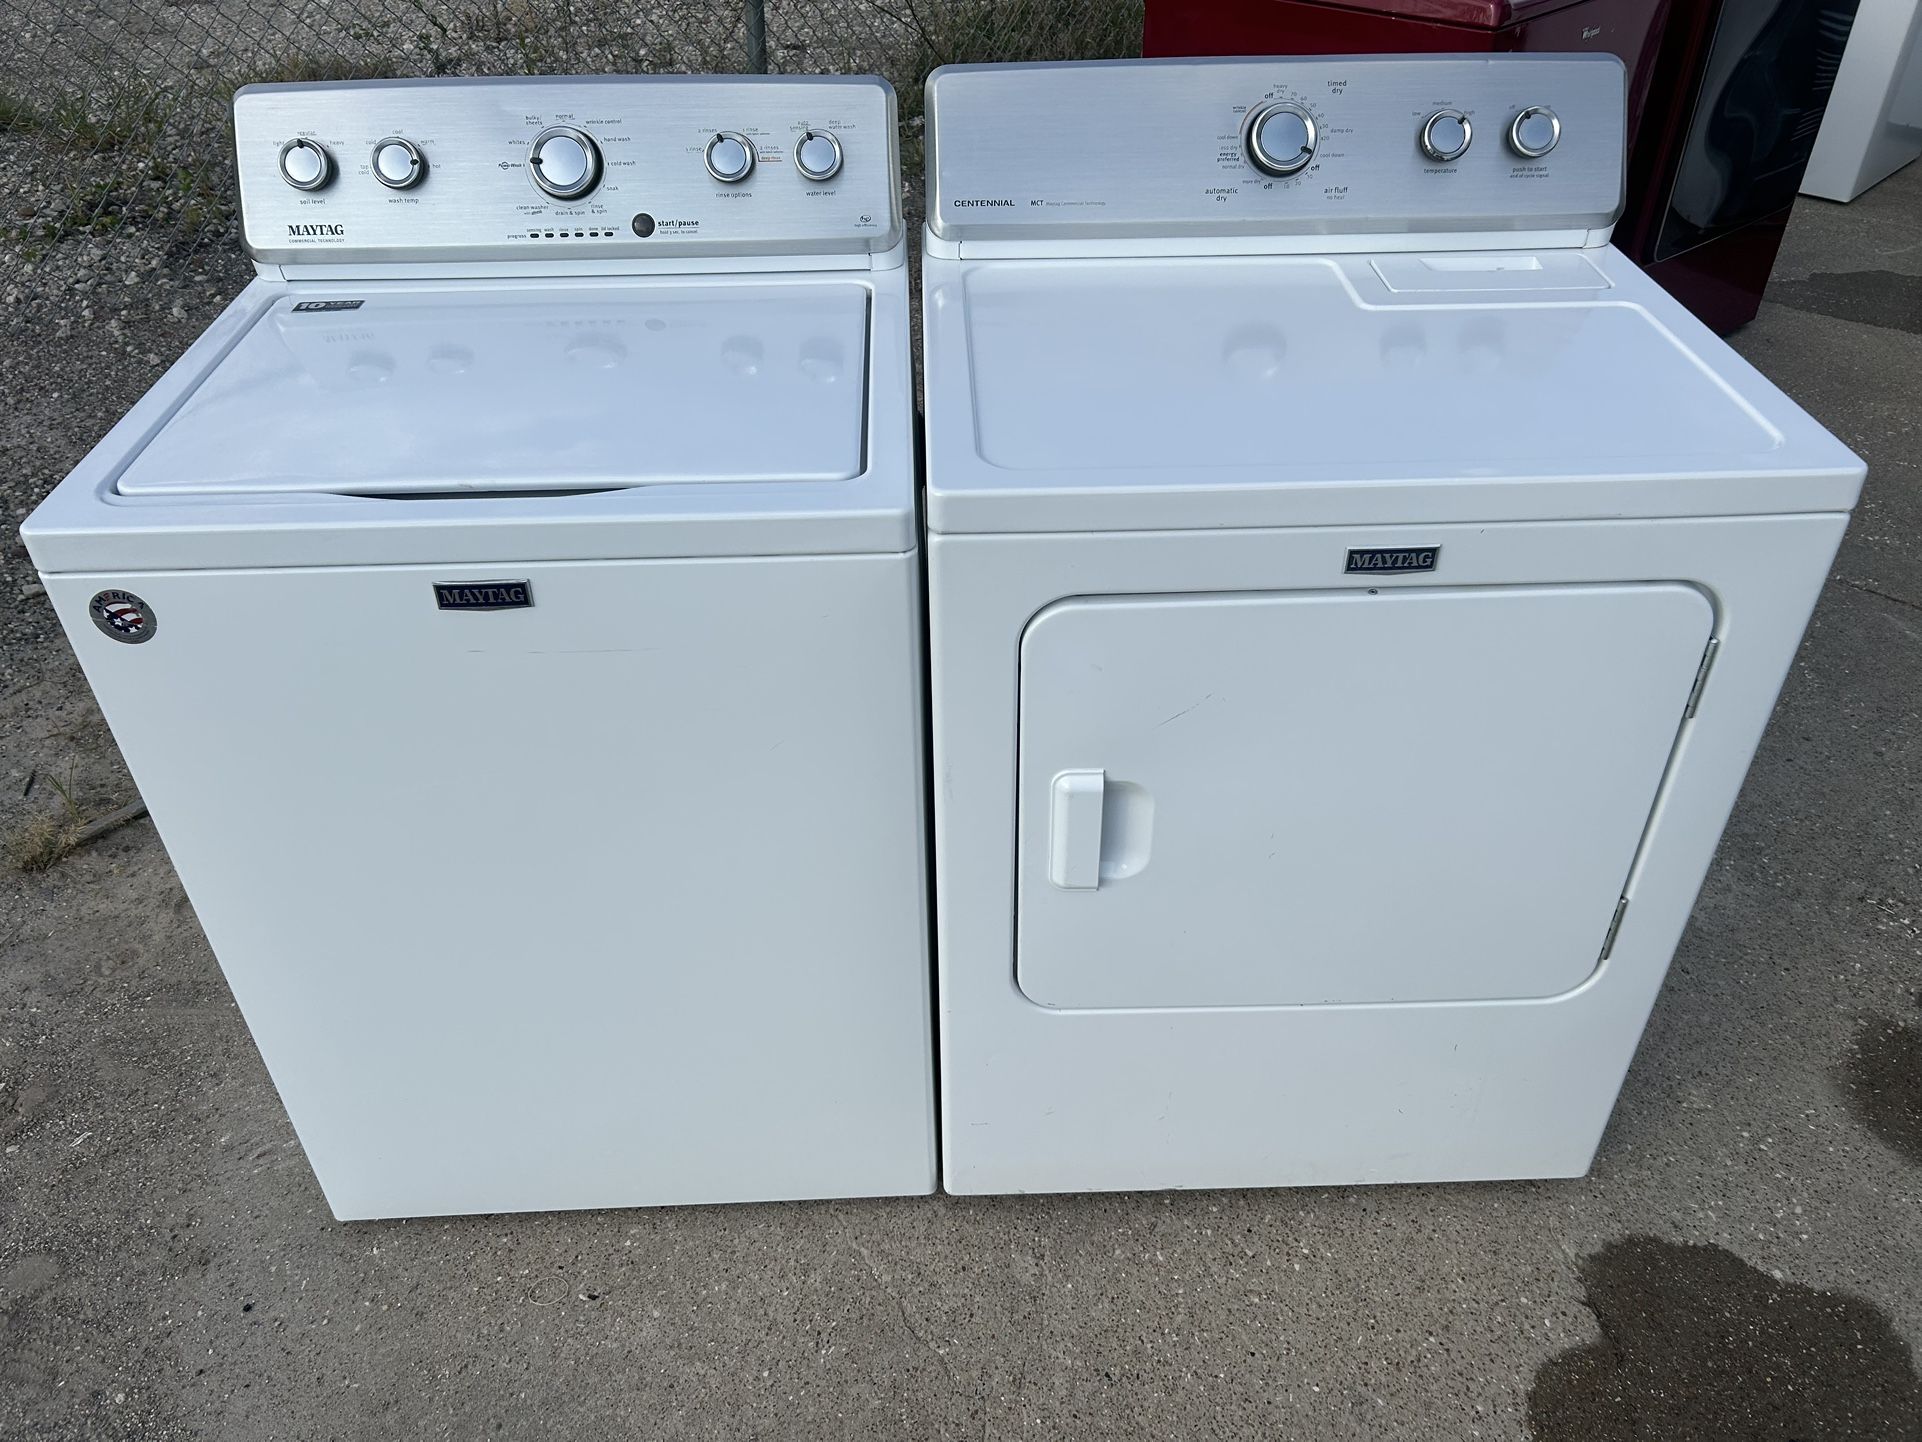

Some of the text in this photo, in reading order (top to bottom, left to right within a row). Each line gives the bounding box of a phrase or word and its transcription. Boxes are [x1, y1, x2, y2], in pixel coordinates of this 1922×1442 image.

[1334, 186, 1348, 194] fluff
[1030, 199, 1044, 207] MCT
[657, 219, 700, 228] start/pause
[287, 223, 345, 236] MAYTAG
[1350, 552, 1433, 568] MAYTAG
[440, 588, 524, 604] MAYTAG
